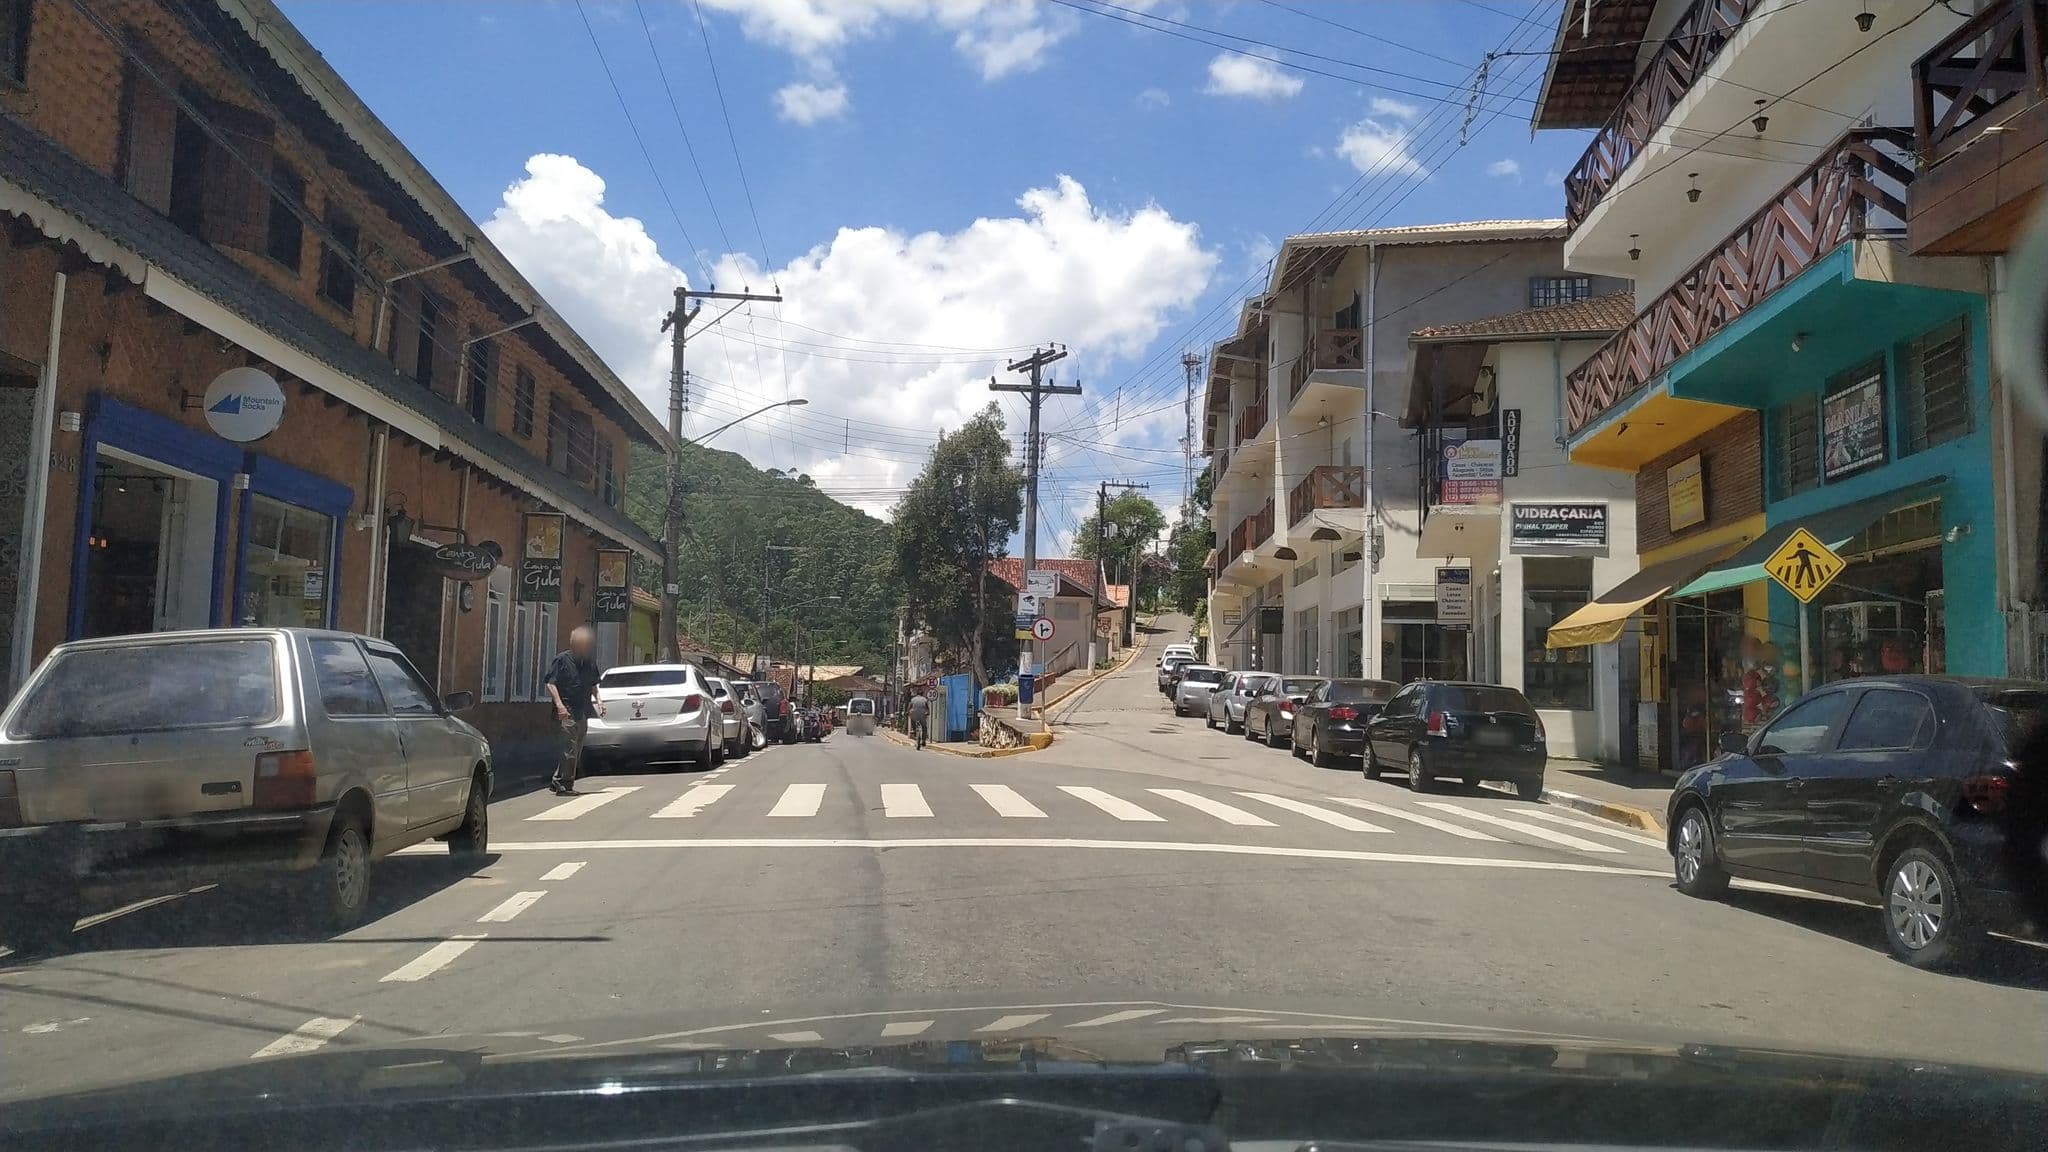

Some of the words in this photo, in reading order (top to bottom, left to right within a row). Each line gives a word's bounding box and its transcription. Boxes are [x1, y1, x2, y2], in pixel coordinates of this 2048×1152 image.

[242, 402, 266, 411] Socks
[243, 395, 280, 405] Mountain
[1506, 410, 1517, 475] ADVOGADO
[1515, 508, 1603, 520] VIDRAÇARIA
[463, 556, 491, 572] Gula
[524, 569, 560, 590] Gula
[596, 596, 626, 612] Gula
